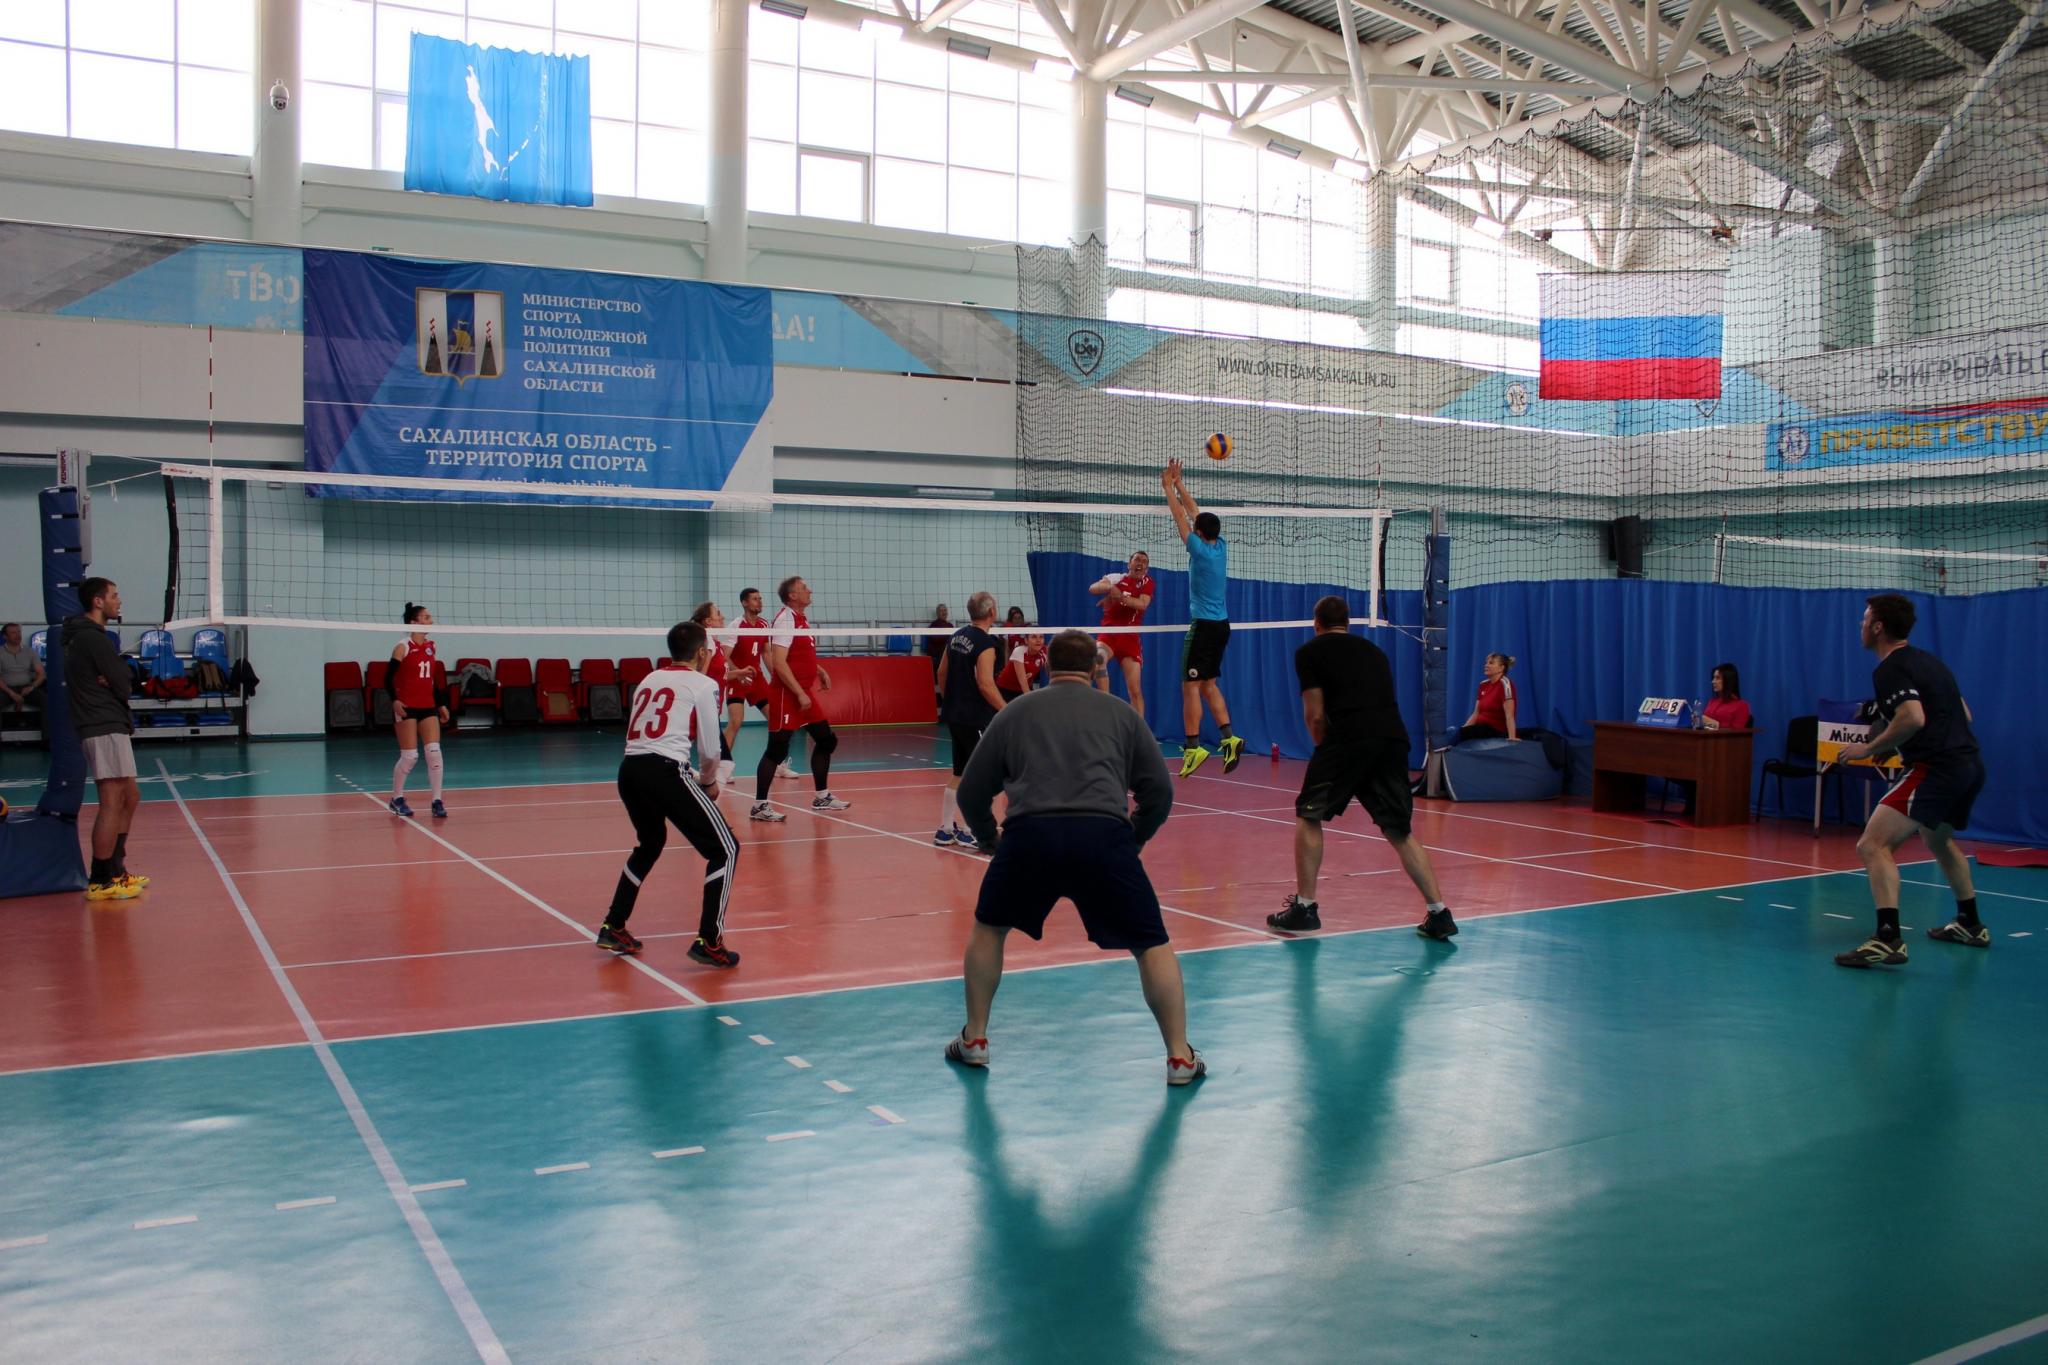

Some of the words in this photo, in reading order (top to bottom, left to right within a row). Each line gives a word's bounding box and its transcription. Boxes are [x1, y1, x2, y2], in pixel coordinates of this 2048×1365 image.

[522, 293, 641, 314] МИНИСТЕРСТВО
[522, 309, 582, 324] СПОРТА
[523, 326, 535, 337] И
[539, 327, 647, 345] МОЛОДЕЖНОЙ
[524, 341, 611, 357] ПОЛИТИКИ
[523, 359, 657, 379] САХАЛИНСКОЙ
[1217, 357, 1397, 389] WWW.ONETEAMSAKHALIN.RU
[1877, 350, 2033, 389] ВЫИГРЫВАТЬ
[523, 377, 605, 393] ОБЛАСТИ
[399, 427, 558, 449] САХАЛИНСКАЯ
[564, 433, 657, 452] ОБЛАСТЬ
[1821, 412, 2048, 453] ПРИВЕТСТВУ
[425, 449, 562, 469] ТЕРРИТОРИЯ
[569, 454, 648, 472] СПОРТА
[751, 641, 759, 656] 4
[418, 661, 430, 678] 11
[627, 687, 675, 740] 23
[783, 714, 789, 724] 1
